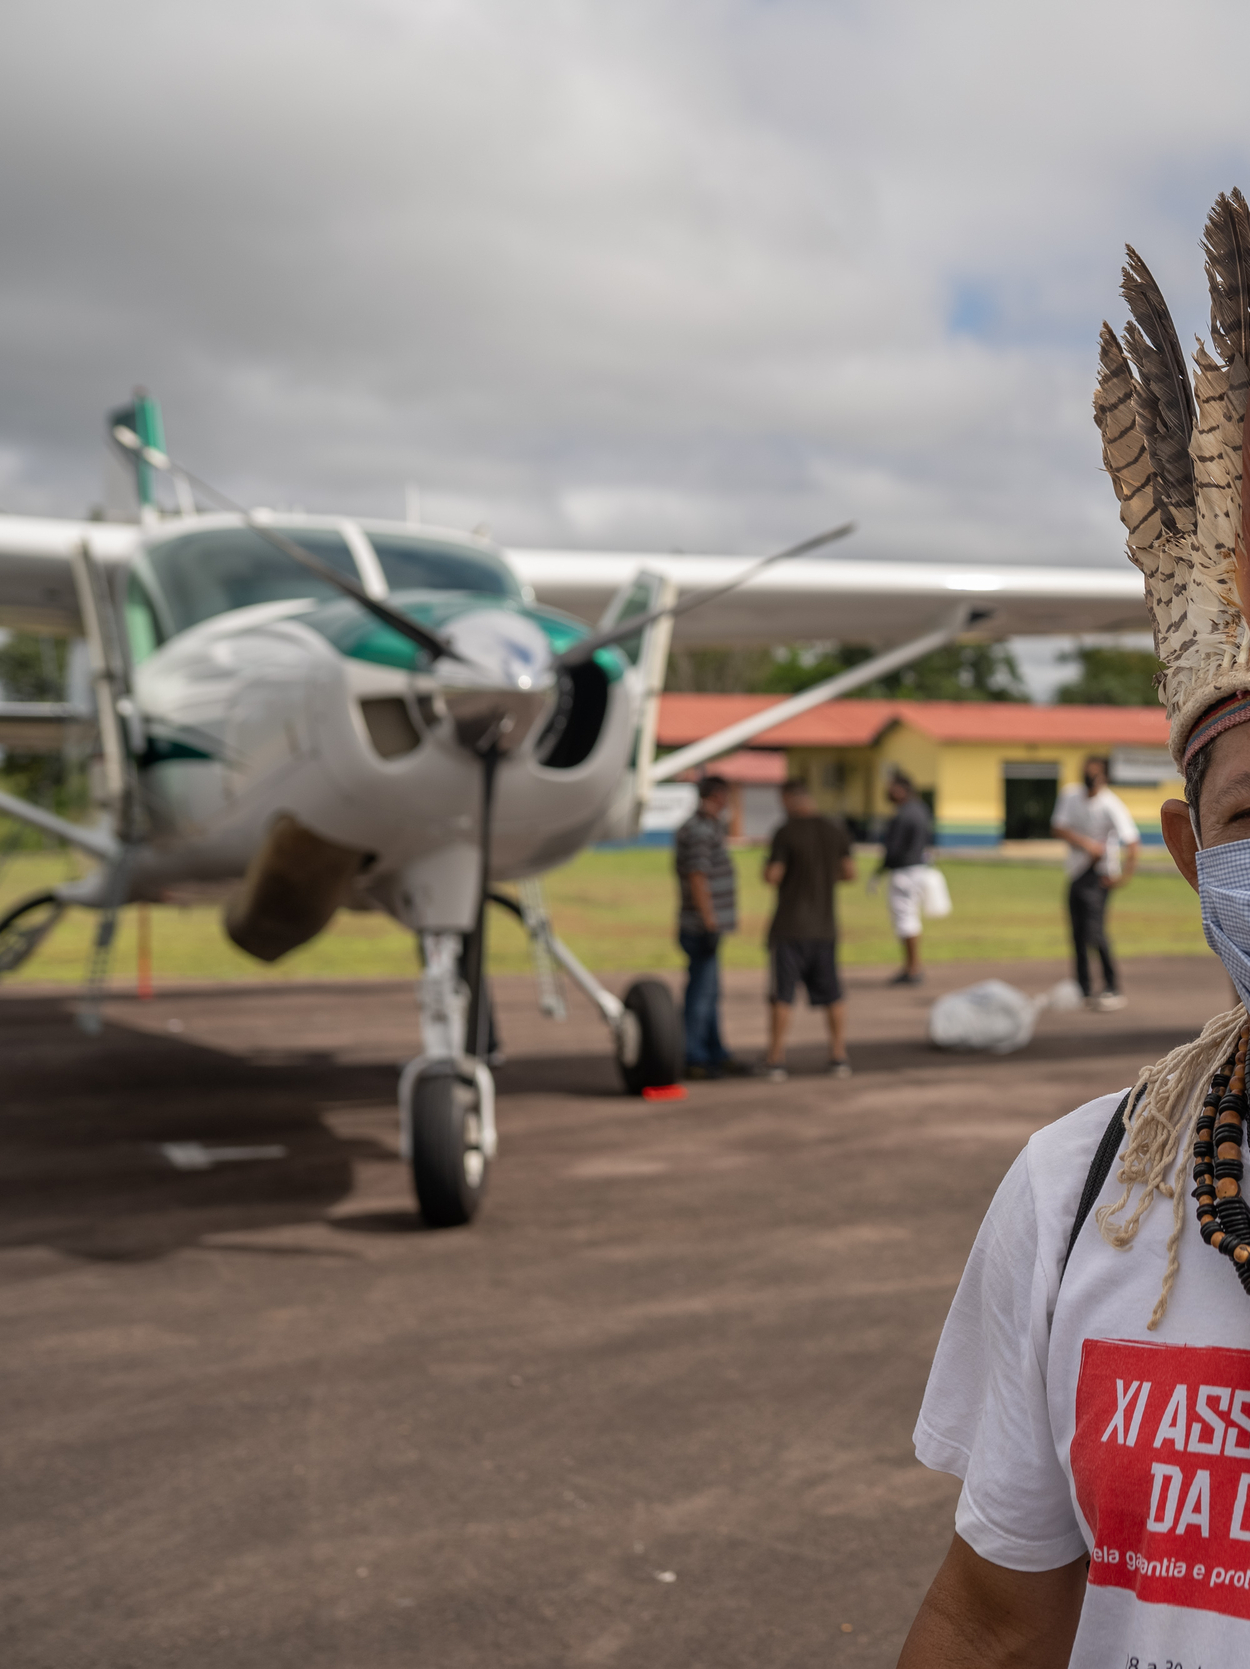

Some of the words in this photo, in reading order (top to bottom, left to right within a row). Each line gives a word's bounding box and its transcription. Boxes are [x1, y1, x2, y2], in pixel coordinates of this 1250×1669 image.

[1101, 1378, 1152, 1448] XI
[1146, 1461, 1211, 1539] DA
[1093, 1545, 1120, 1564] ela
[1126, 1550, 1187, 1578] gaantia
[1192, 1563, 1206, 1580] e
